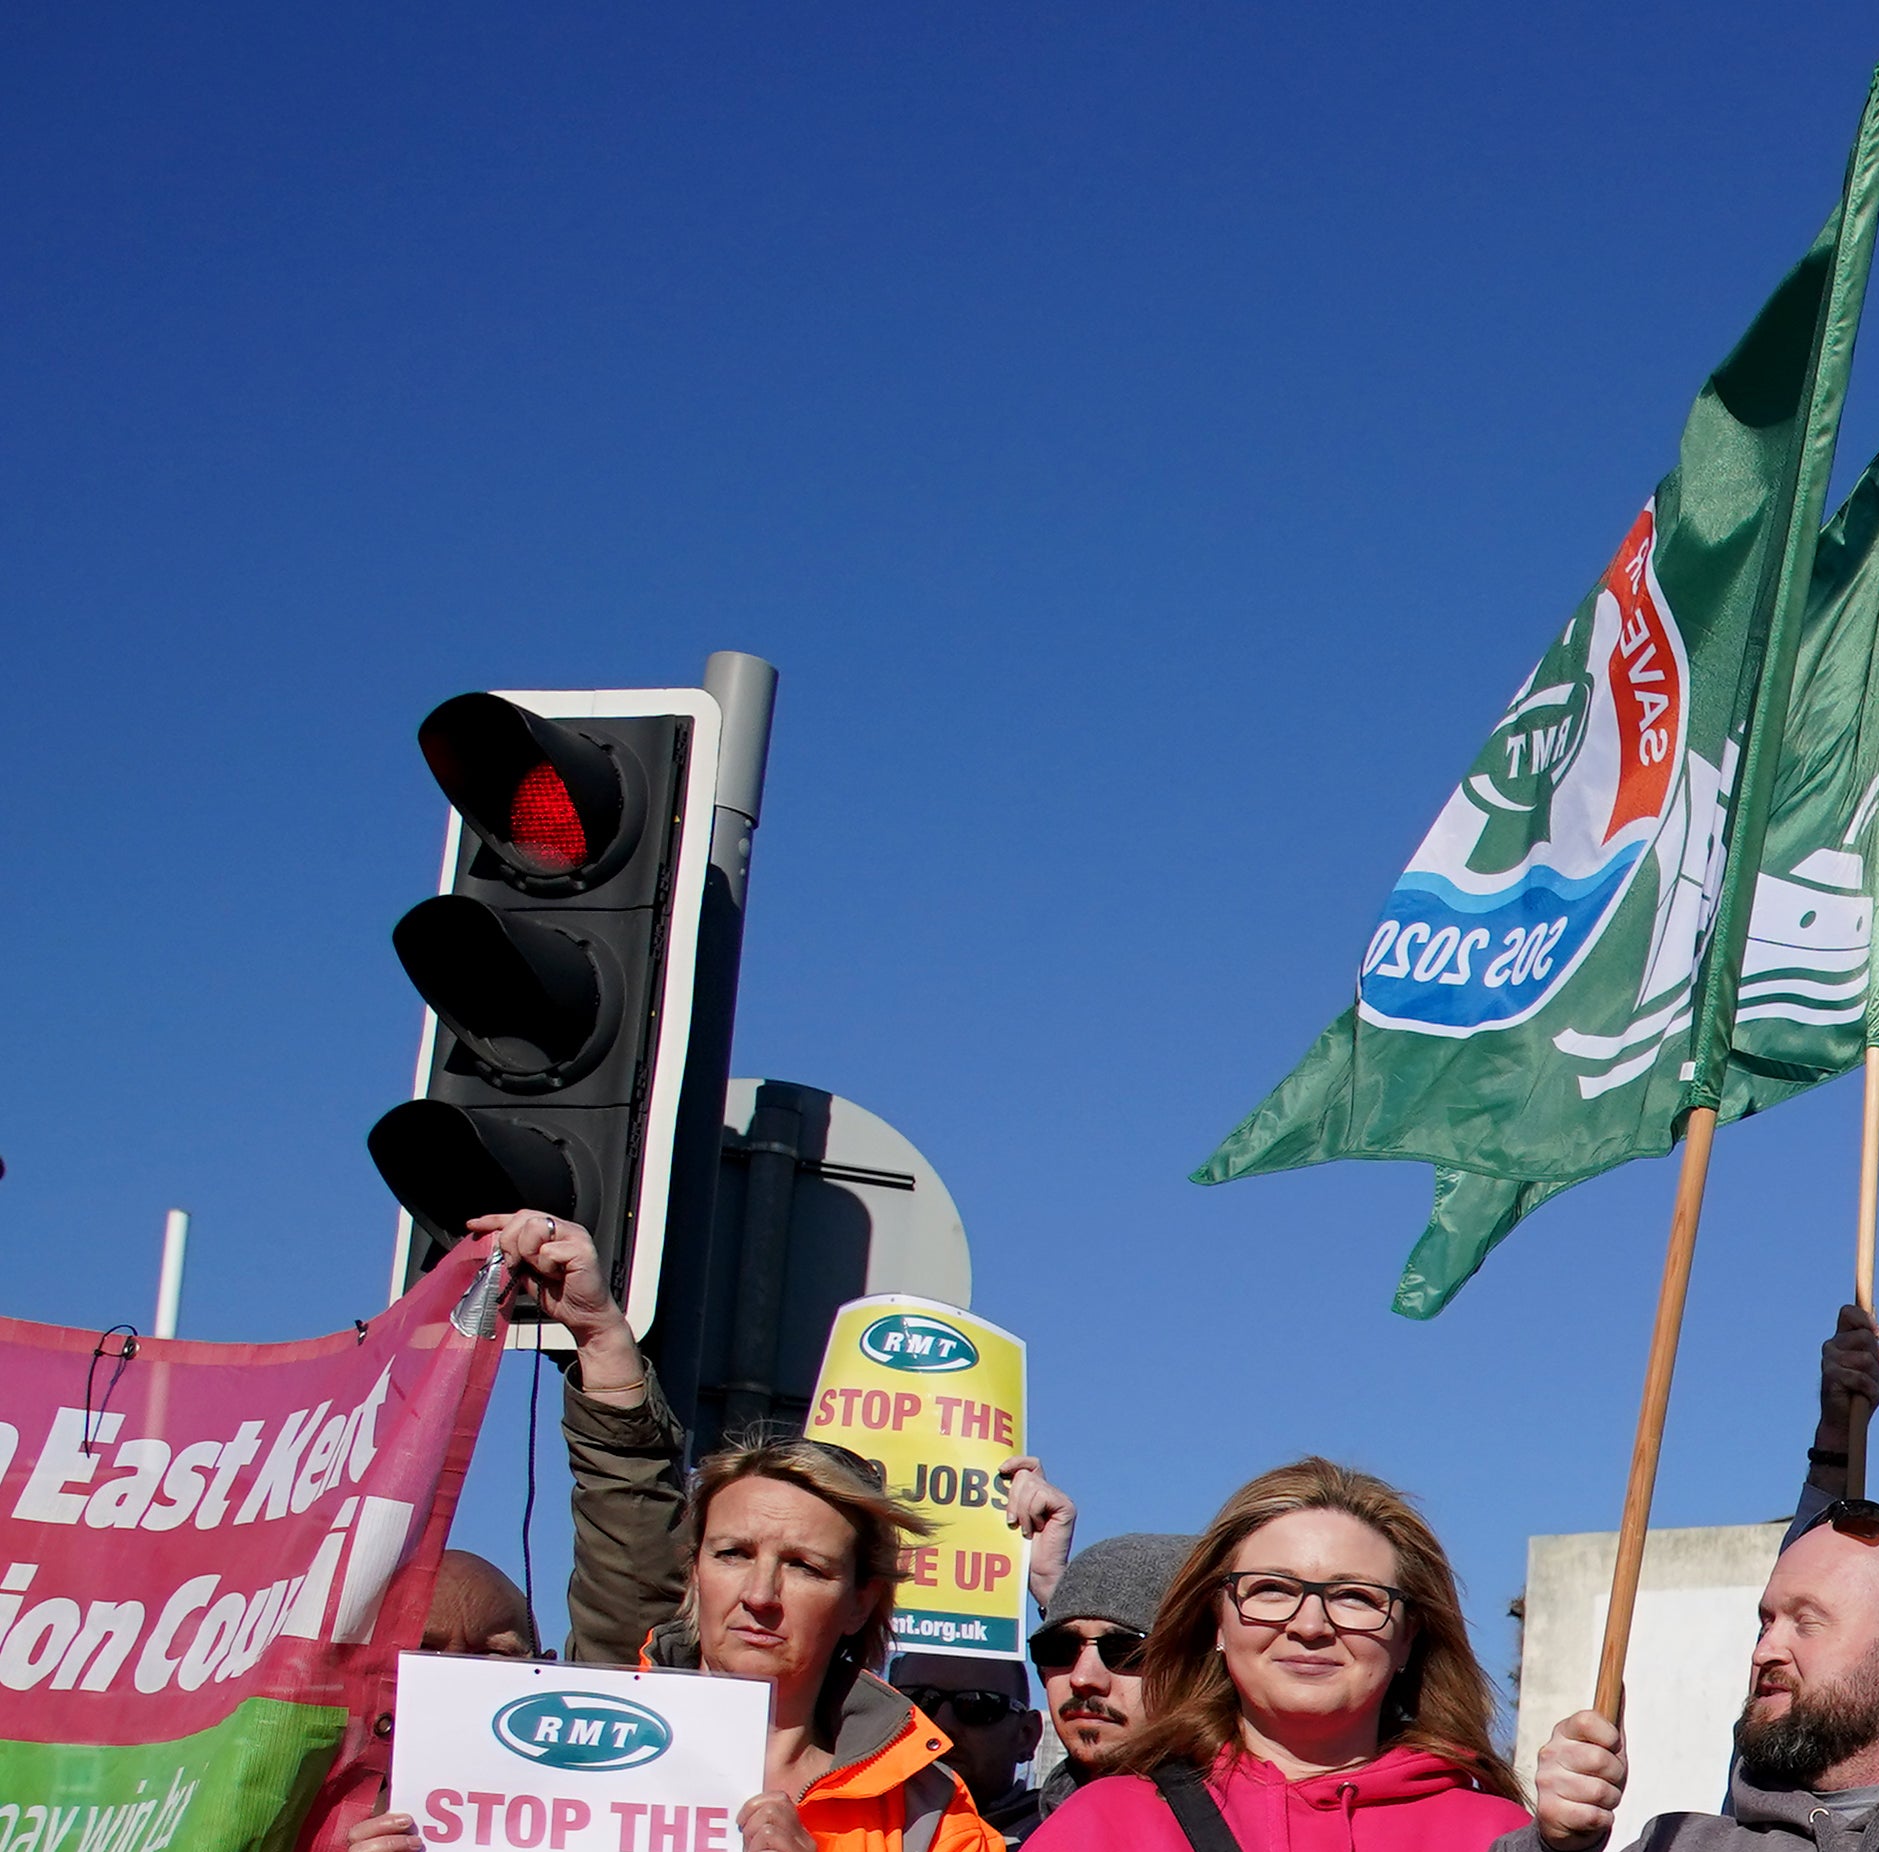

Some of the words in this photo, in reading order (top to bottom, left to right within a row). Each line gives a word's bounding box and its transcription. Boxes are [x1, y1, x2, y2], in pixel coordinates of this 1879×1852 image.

[882, 1331, 957, 1360] RMT
[814, 1388, 922, 1431] STOP
[934, 1396, 1014, 1448] THE
[11, 1406, 265, 1532] East
[233, 1353, 396, 1526] Kent
[902, 1464, 1012, 1510] JOBS
[954, 1550, 1012, 1592] UP
[895, 1614, 988, 1642] mt.org.uk
[533, 1715, 640, 1749] RMT
[422, 1788, 592, 1850] STOP
